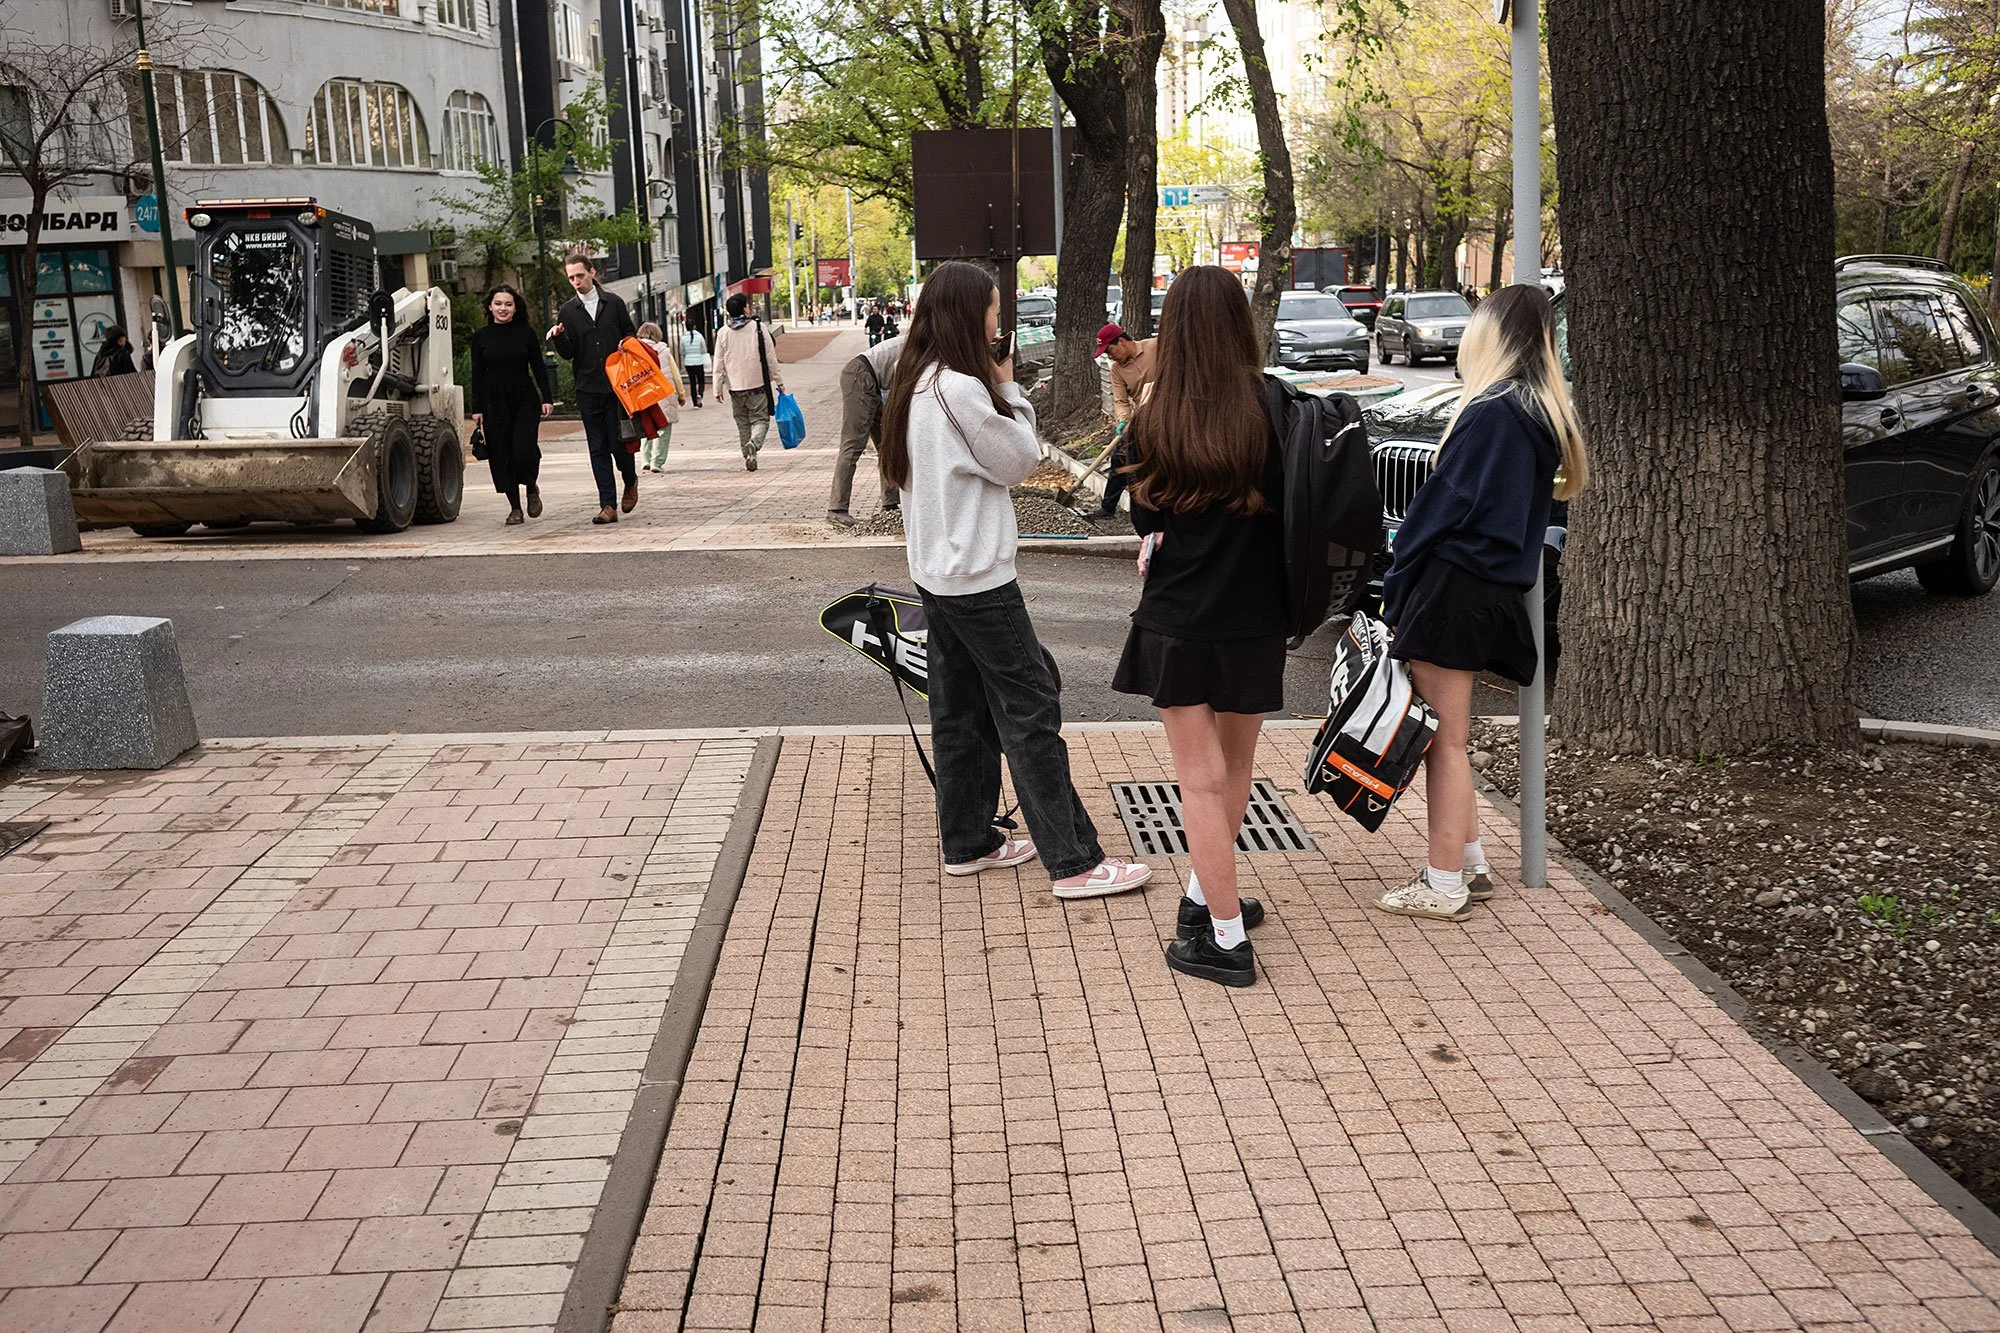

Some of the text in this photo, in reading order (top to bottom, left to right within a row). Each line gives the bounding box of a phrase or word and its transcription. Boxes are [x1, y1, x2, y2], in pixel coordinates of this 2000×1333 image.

[244, 231, 287, 242] NKB GROUP
[435, 314, 449, 331] 830
[1341, 763, 1380, 791] HEAD
